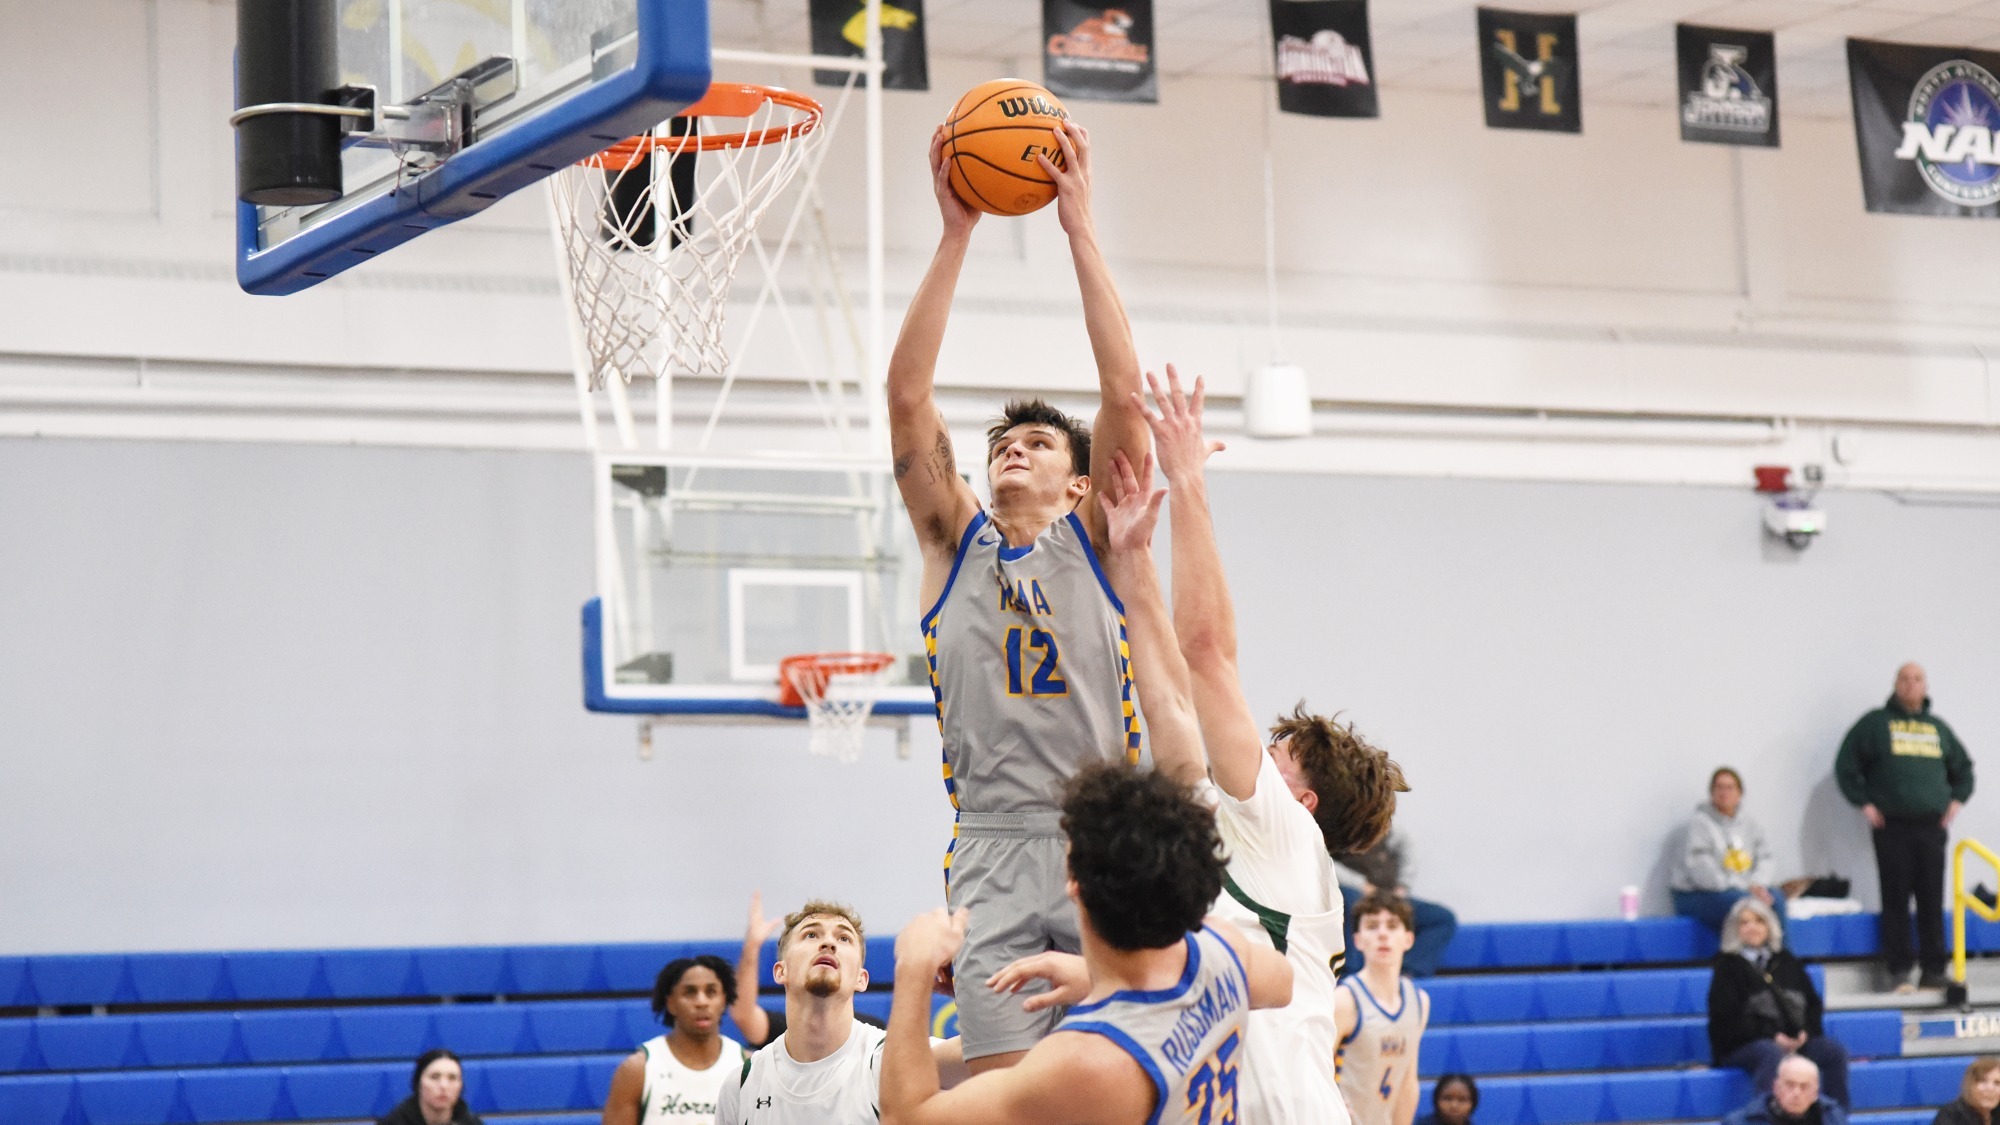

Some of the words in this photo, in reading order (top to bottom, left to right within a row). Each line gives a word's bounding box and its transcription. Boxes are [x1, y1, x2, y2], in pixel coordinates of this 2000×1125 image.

[1954, 65, 2000, 101] ATLAN
[1894, 122, 2000, 167] NA
[1002, 624, 1069, 698] 12
[1161, 969, 1241, 1077] RUSSMAN
